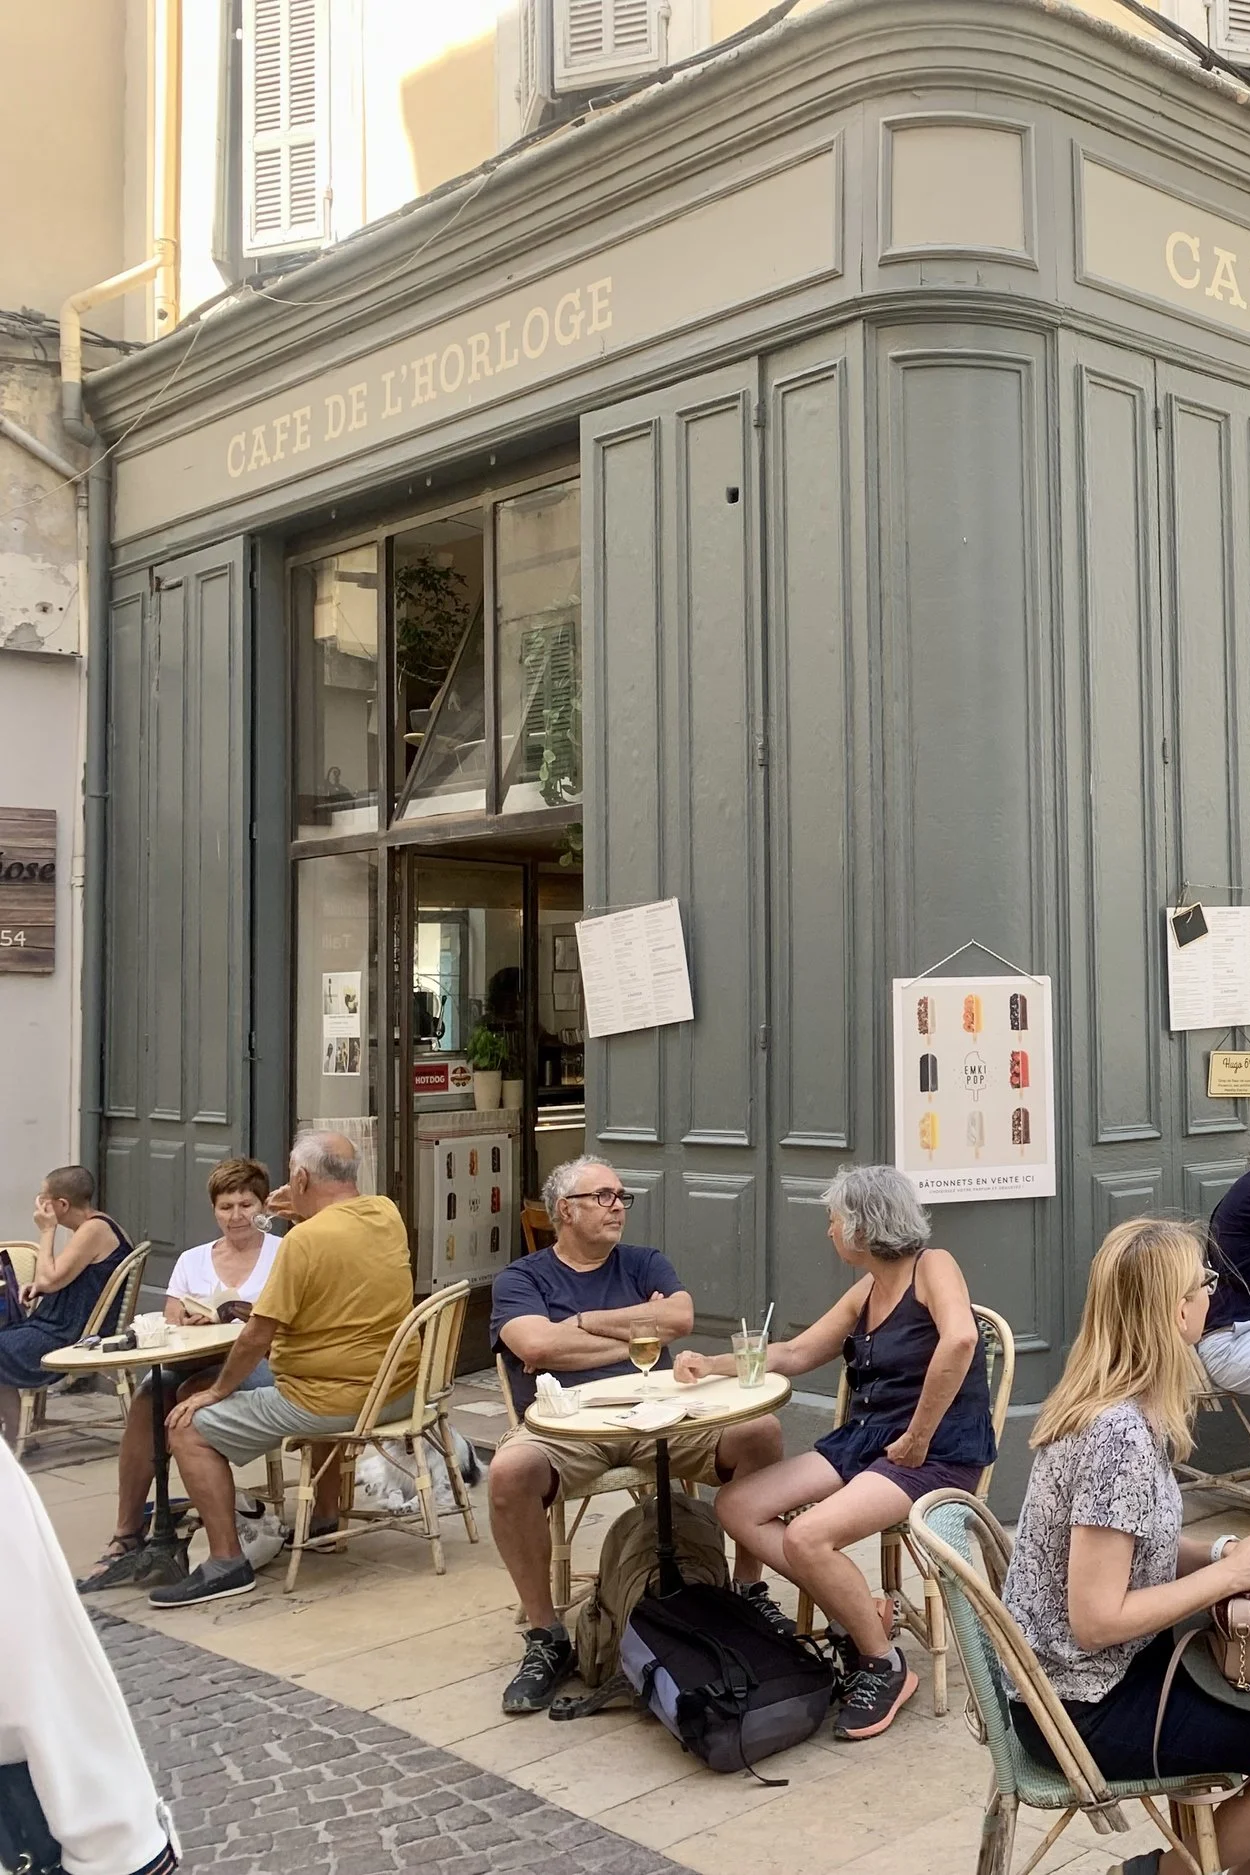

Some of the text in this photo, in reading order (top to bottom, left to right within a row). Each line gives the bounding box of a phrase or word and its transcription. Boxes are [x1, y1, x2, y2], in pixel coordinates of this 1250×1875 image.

[226, 276, 612, 478] CAFE DE L'HORLOGE
[0, 852, 56, 881] ose
[964, 1065, 987, 1075] EMKI
[1222, 1057, 1243, 1074] Hugo
[415, 1075, 445, 1085] HOTDOG
[966, 1075, 985, 1085] POP
[919, 1178, 973, 1188] BÂTONNETS
[991, 1176, 1019, 1184] VENTE
[1022, 1175, 1035, 1183] ICI
